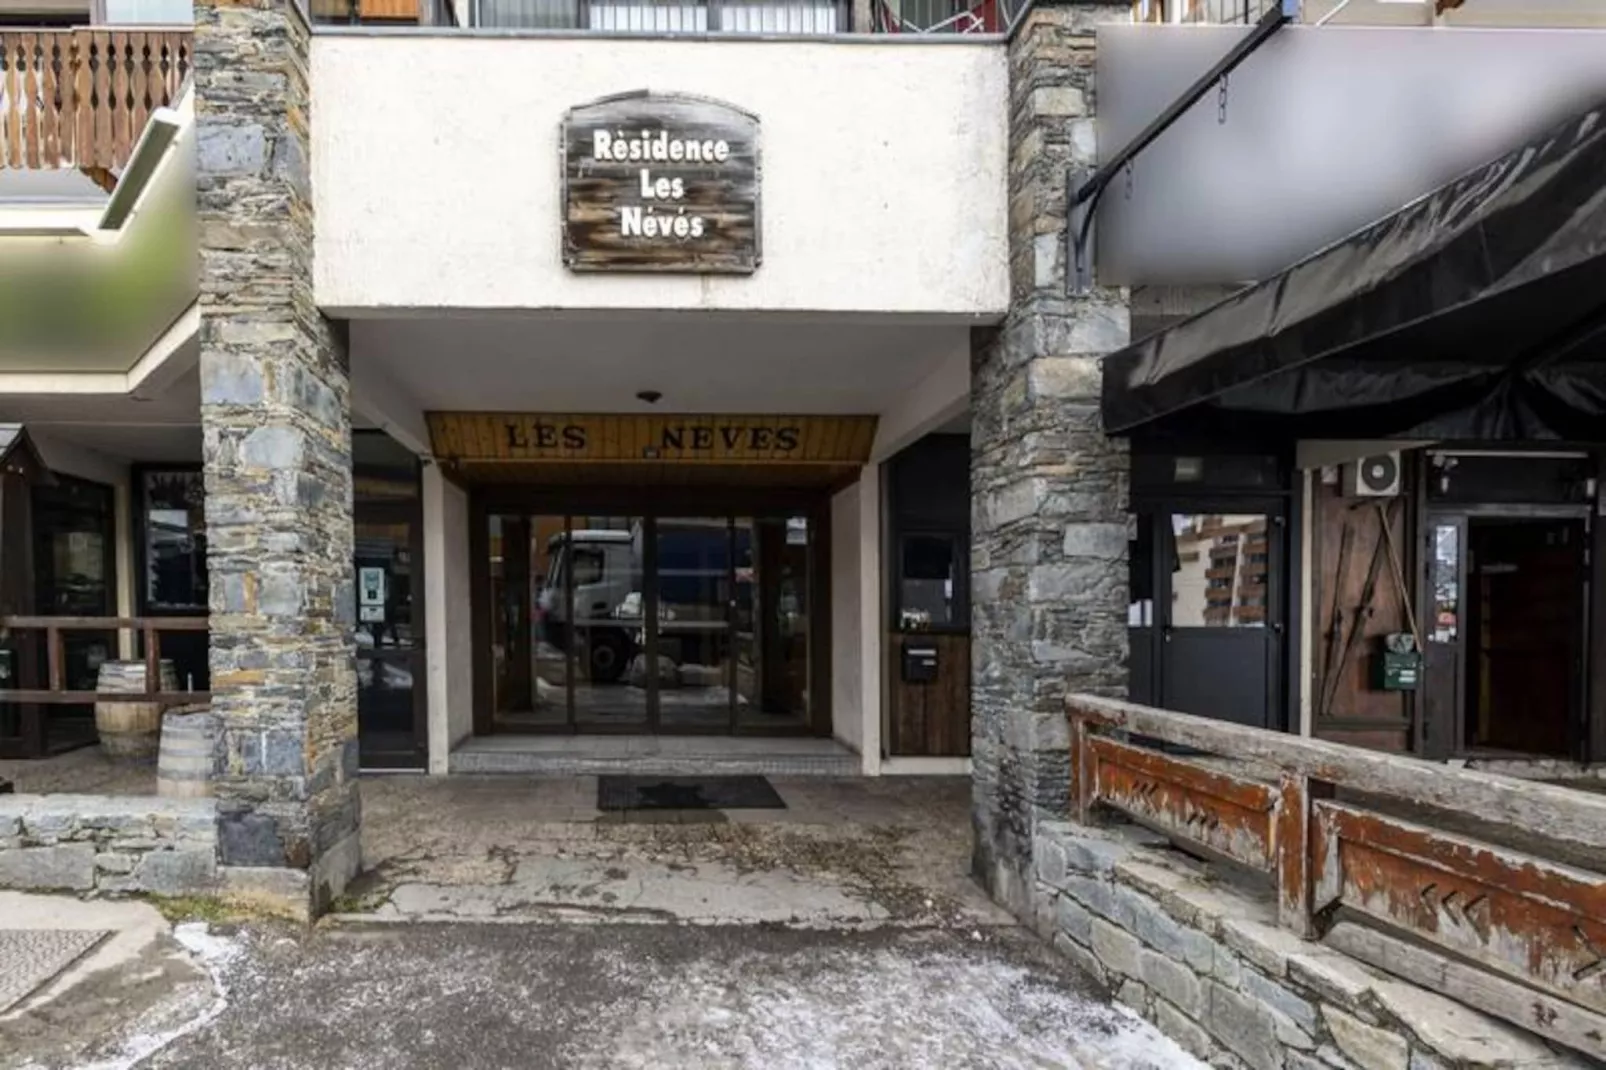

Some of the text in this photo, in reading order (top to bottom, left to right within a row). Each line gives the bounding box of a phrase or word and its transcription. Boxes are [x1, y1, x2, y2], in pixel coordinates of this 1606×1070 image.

[640, 168, 685, 199] Les
[621, 206, 704, 237] Névés
[505, 424, 801, 451] LES NEVES
